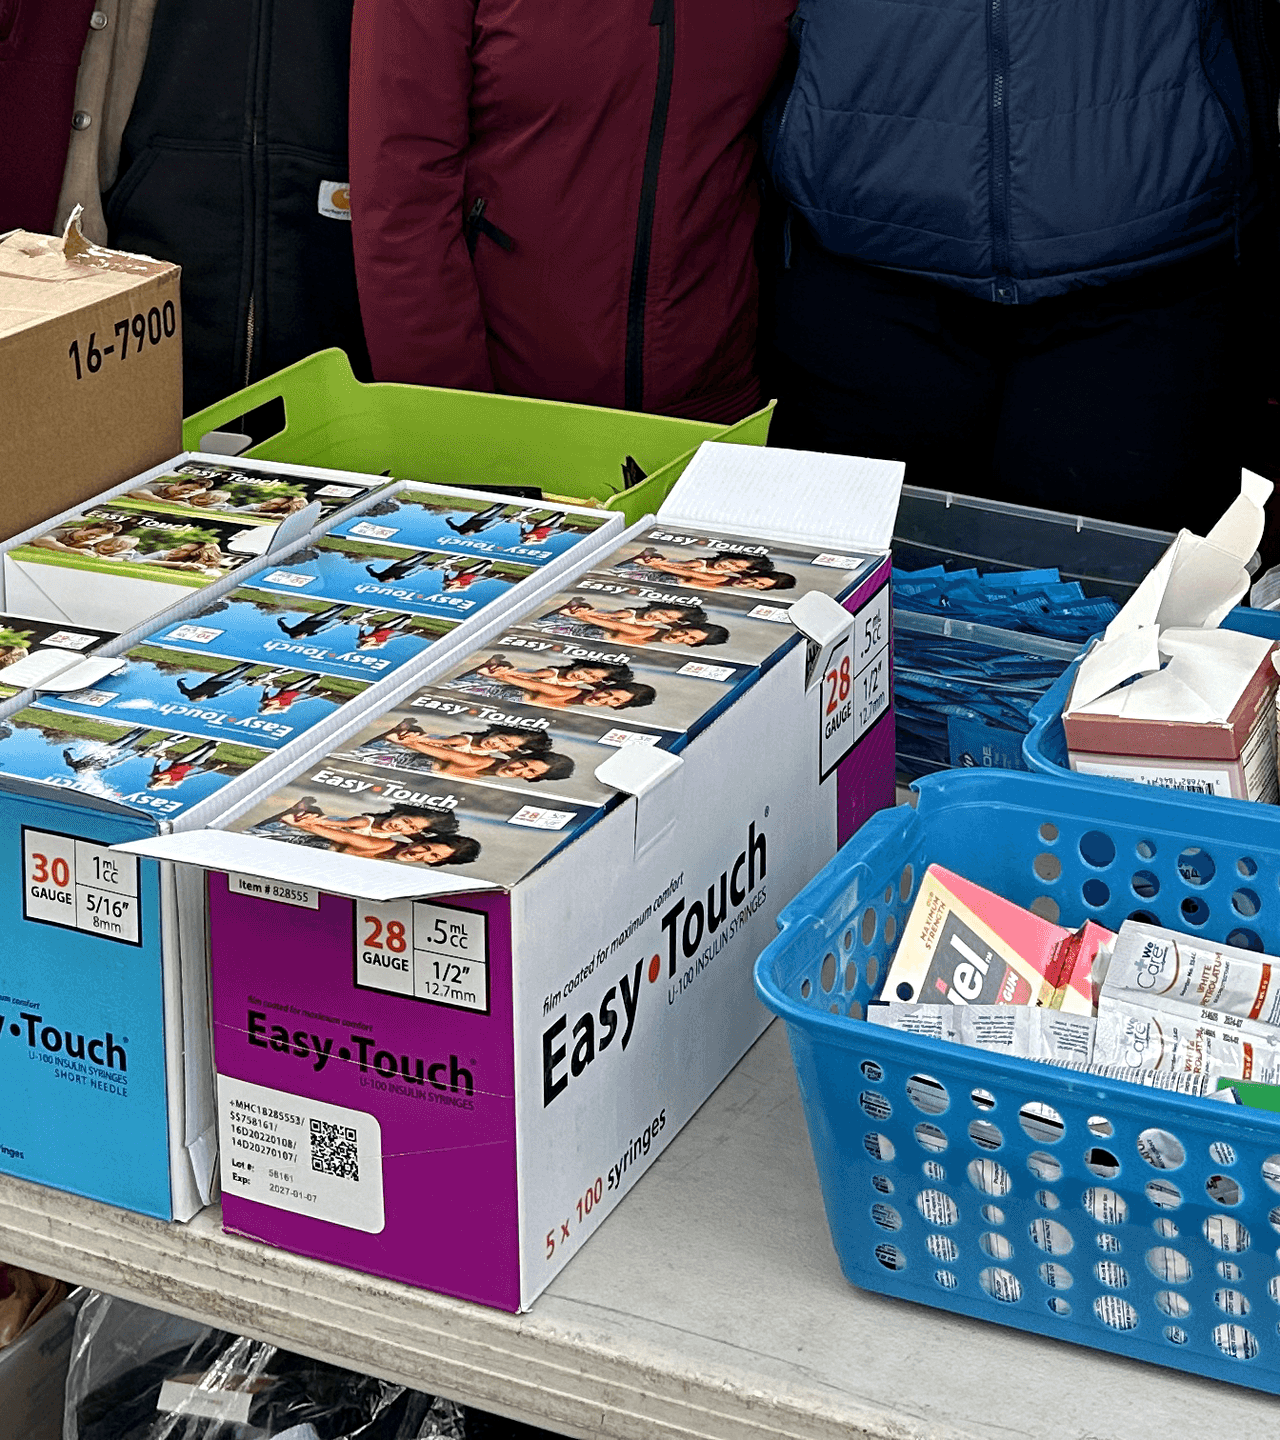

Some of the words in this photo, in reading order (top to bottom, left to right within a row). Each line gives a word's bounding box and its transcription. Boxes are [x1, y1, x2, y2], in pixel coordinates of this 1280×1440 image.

[69, 300, 175, 380] 16-7900
[647, 531, 698, 546] Easy
[706, 537, 769, 556] Touch
[353, 584, 418, 602] Touch
[427, 593, 477, 610] Easy
[262, 641, 332, 660] Touch
[336, 652, 392, 672] Easy
[497, 635, 554, 653] Easy
[560, 642, 632, 664] Touch
[826, 655, 850, 717] 28
[160, 704, 230, 725] Touch
[236, 717, 294, 738] Easy
[410, 695, 470, 715] Easy
[477, 706, 551, 731] Touch
[825, 700, 852, 740] GAUGE
[310, 770, 373, 793] Easy
[380, 783, 459, 810] Touch
[32, 853, 70, 887] 30
[93, 856, 100, 879] 1
[103, 870, 118, 884] CC
[31, 886, 72, 905] GAUGE
[86, 894, 129, 918] 5/16"
[238, 878, 262, 893] Item
[272, 886, 309, 903] 828555
[93, 916, 121, 933] 8mm
[363, 915, 407, 954] 28
[426, 918, 447, 945] .5
[450, 923, 468, 936] mL
[920, 896, 940, 943] MAXIMUM
[925, 902, 947, 951] STRENGTH
[450, 934, 468, 950] CC
[543, 994, 562, 1018] film
[563, 962, 596, 999] coated
[595, 946, 609, 970] for
[609, 901, 652, 955] maximum
[653, 871, 685, 910] comfort
[668, 972, 694, 1006] U-100
[694, 931, 730, 978] INSULIN
[729, 885, 767, 940] SYRINGES
[1142, 942, 1154, 958] We
[362, 951, 410, 972] GAUGE
[432, 961, 470, 985] 1/2"
[543, 957, 645, 1109] Easy
[661, 820, 767, 980] Touch
[1136, 946, 1163, 989] Care
[1196, 964, 1212, 994] WHITE
[1199, 952, 1223, 1008] PETROLATUM
[424, 981, 476, 1004] 12.7mm
[1002, 973, 1020, 1000] GUM
[20, 1012, 127, 1072] Touch
[248, 1010, 333, 1073] Easy
[351, 1034, 475, 1097] Touch
[1125, 1022, 1150, 1068] Care
[28, 1051, 54, 1064] U-100
[55, 1056, 87, 1074] INSULIN
[88, 1066, 128, 1085] SYRINGES
[54, 1068, 87, 1086] SHORT
[90, 1078, 128, 1097] NEEDLE
[360, 1077, 387, 1091] U-100
[388, 1083, 427, 1101] INSULIN
[428, 1090, 474, 1110] SYRINGES
[230, 1124, 297, 1150] 16D20220108/
[231, 1136, 298, 1163] 14D20270107/
[232, 1159, 245, 1171] Lot
[268, 1168, 294, 1184] 58161
[546, 1228, 555, 1260] 5
[561, 1217, 570, 1244] x
[576, 1176, 603, 1224] 100
[607, 1108, 667, 1191] syringes
[232, 1172, 251, 1186] Exp:
[269, 1182, 317, 1204] 2027-01-07
